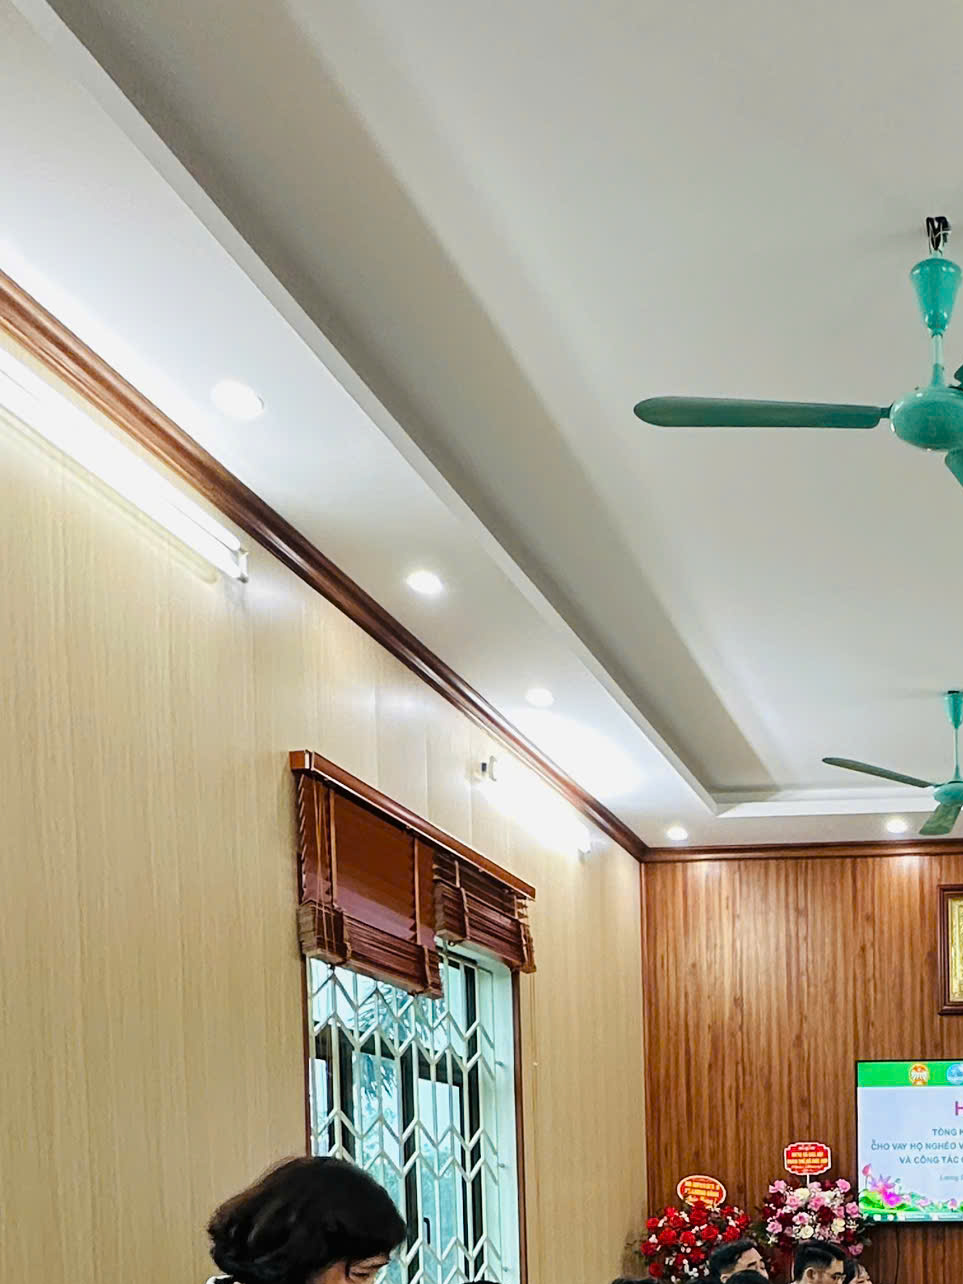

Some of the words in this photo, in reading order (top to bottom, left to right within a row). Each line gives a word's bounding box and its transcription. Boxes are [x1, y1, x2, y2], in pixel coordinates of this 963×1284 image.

[871, 1142, 890, 1151] CHO
[892, 1142, 907, 1150] VAY
[910, 1141, 923, 1152] HỘ
[899, 1155, 912, 1164] VÀ
[914, 1154, 939, 1164] CÔNG
[941, 1154, 959, 1164] TÁC
